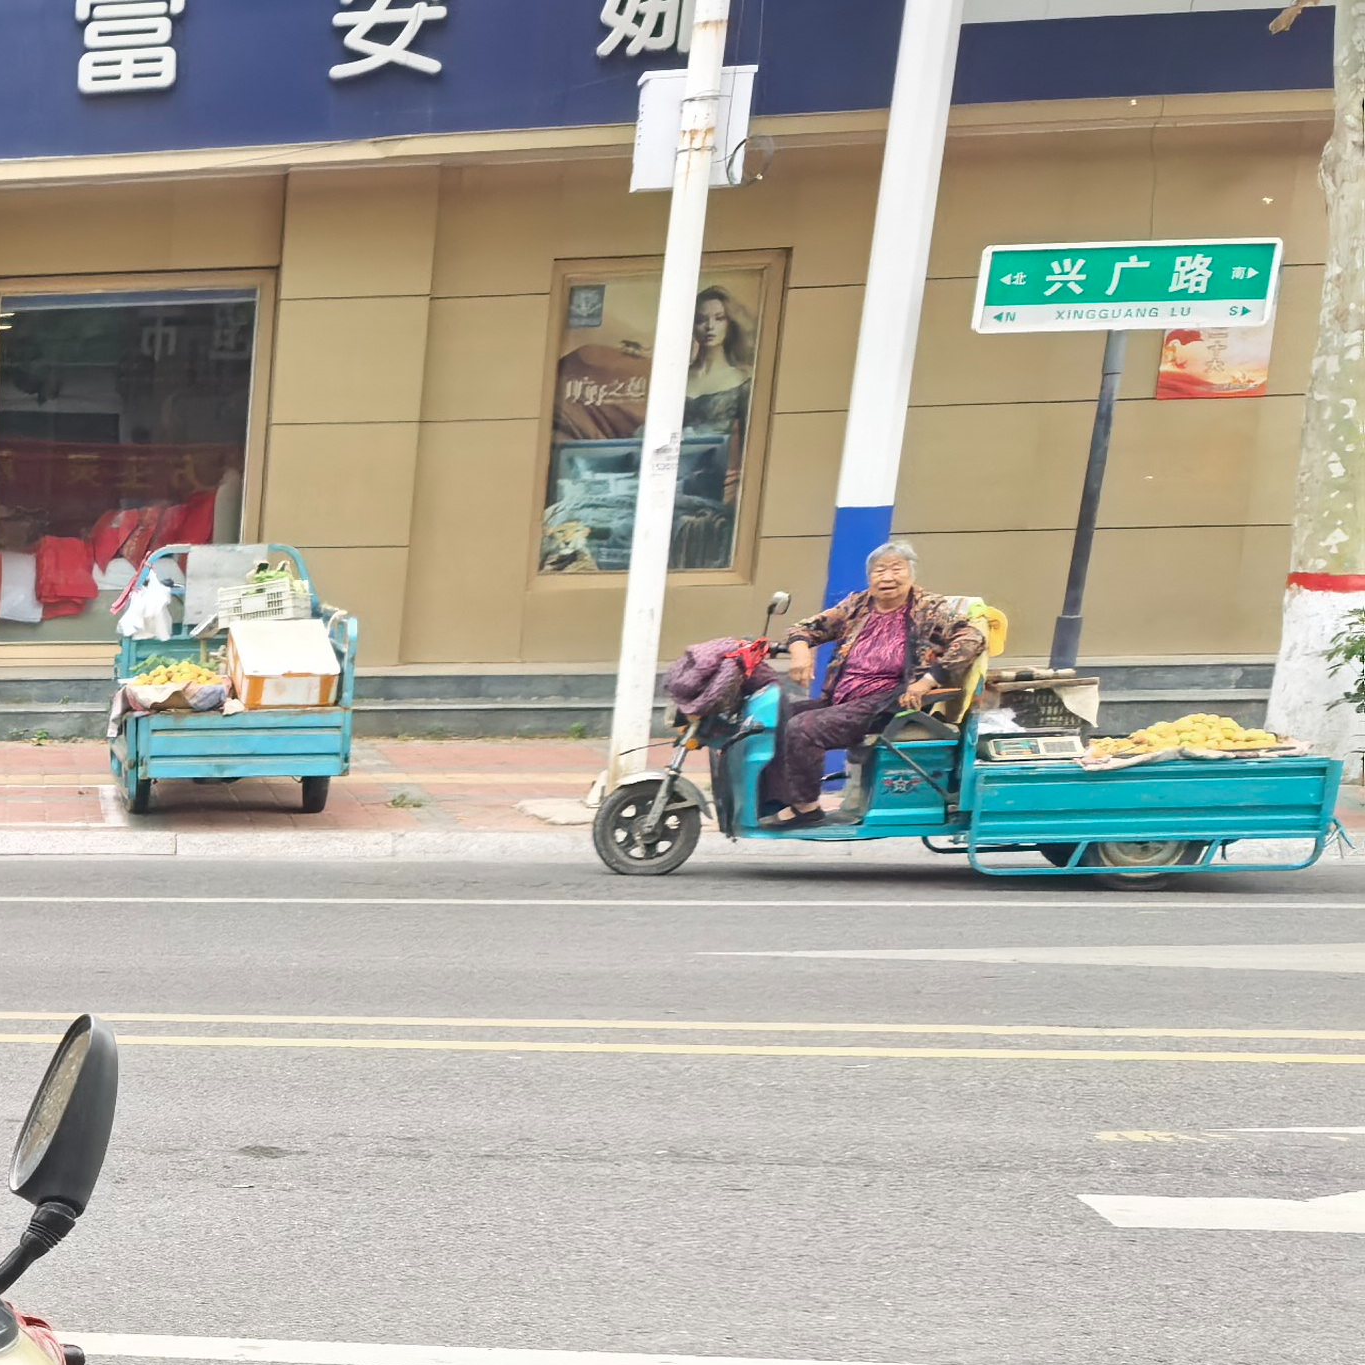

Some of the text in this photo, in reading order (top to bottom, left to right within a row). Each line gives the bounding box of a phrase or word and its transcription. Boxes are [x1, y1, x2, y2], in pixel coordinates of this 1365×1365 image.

[1012, 254, 1245, 296] 北 兴广路 南
[1005, 305, 1238, 323] N XINGGUANG LU S
